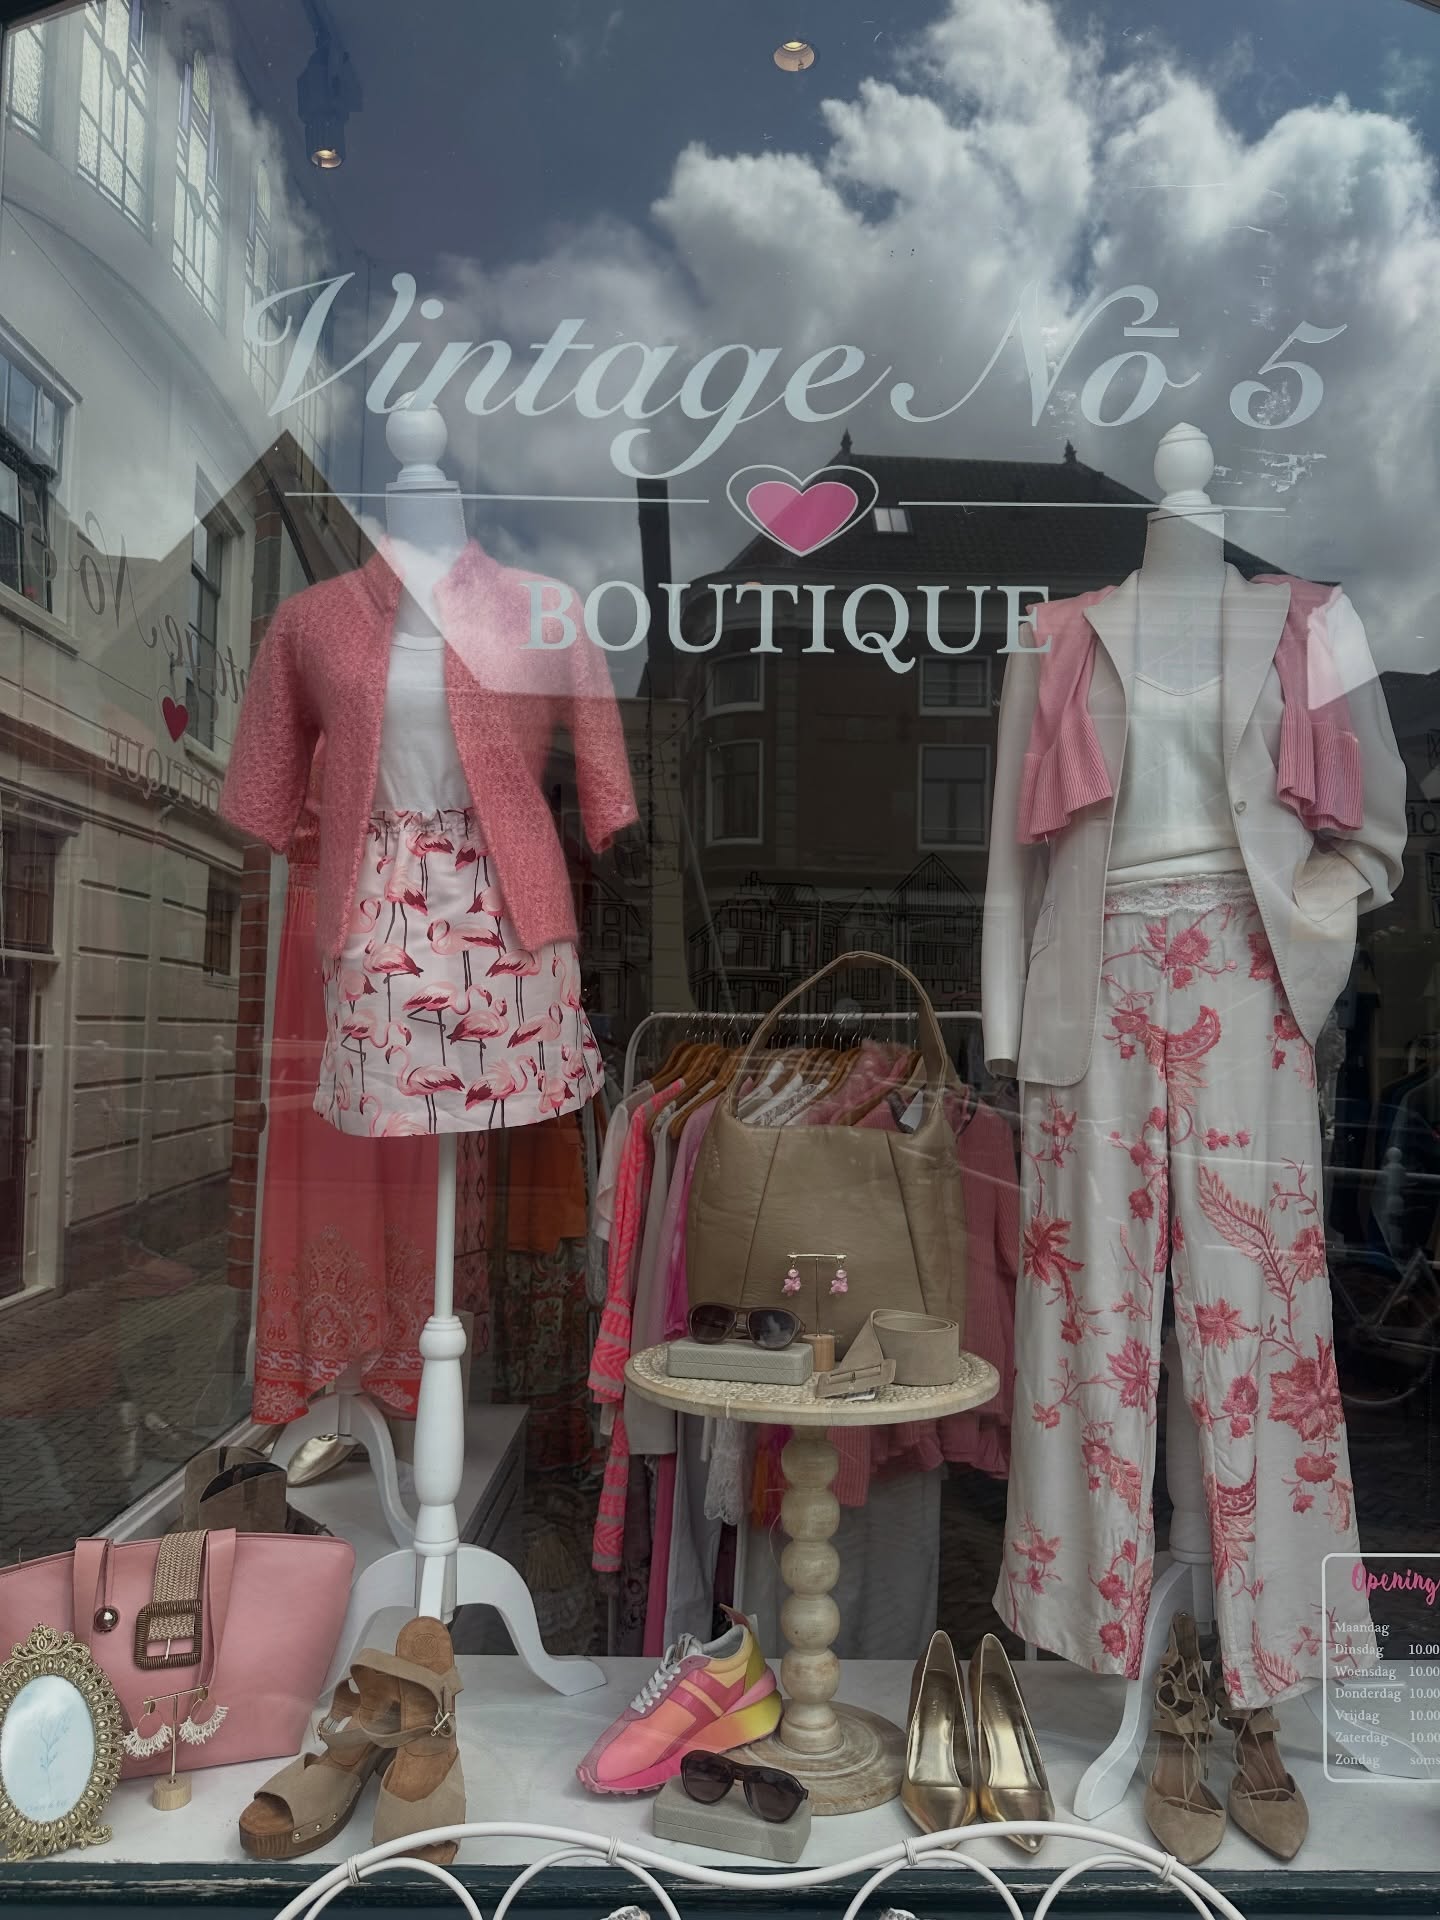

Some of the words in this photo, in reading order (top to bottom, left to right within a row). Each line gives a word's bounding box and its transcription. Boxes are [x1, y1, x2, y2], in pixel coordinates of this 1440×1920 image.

[243, 272, 892, 479] Vintage
[1229, 320, 1348, 430] 5
[520, 580, 1052, 675] BOUTIQUE
[1335, 1621, 1390, 1637] Maandag
[1335, 1643, 1385, 1658] Dinsdag
[1409, 1644, 1440, 1655] 10.00
[1335, 1665, 1397, 1681] Woensdag
[1409, 1666, 1440, 1677] 10.00
[1335, 1687, 1402, 1703] Donderdag
[1410, 1688, 1440, 1698] 10.00
[1335, 1709, 1380, 1725] Vrijdag
[1410, 1710, 1440, 1720] 10.00
[1335, 1731, 1389, 1747] Zaterdag
[1410, 1732, 1440, 1743] 10.00
[1335, 1753, 1380, 1769] Zondag
[1410, 1757, 1440, 1765] soms
